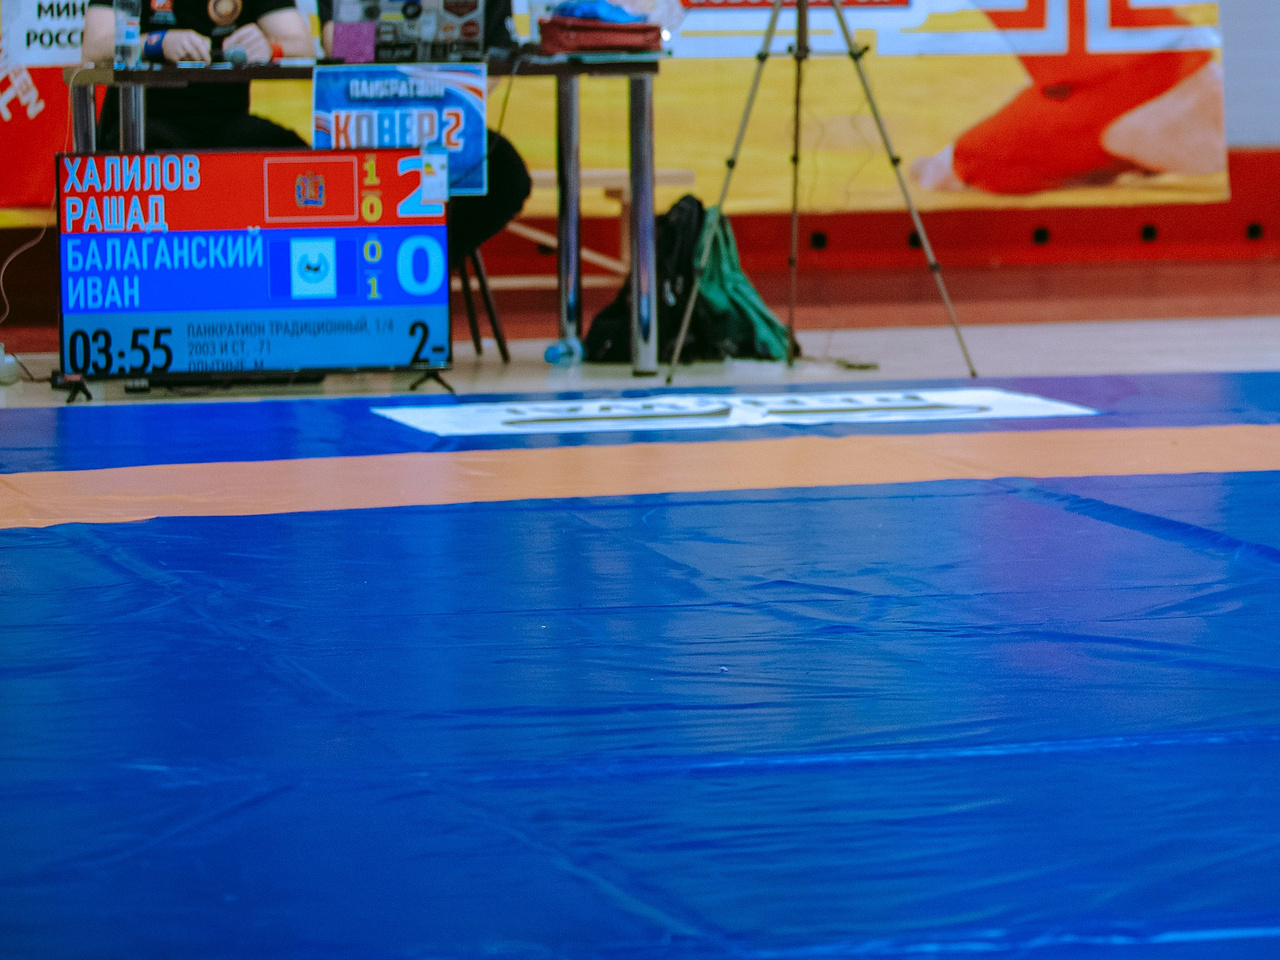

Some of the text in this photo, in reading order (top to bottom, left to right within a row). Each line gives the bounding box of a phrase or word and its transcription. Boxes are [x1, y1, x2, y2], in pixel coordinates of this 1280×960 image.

[26, 29, 84, 49] РОСС
[332, 109, 464, 149] КОВЕР 2
[64, 154, 201, 193] ХАЛИЛОВ
[363, 160, 380, 186] 1
[397, 156, 445, 218] 2
[65, 195, 168, 233] РАШАД
[361, 196, 383, 223] 0
[67, 226, 264, 272] БАЛАГАНСКИЙ
[363, 240, 382, 262] 0
[396, 234, 445, 296] 0
[67, 274, 140, 310] ИВАН
[366, 277, 382, 300] 1
[69, 327, 173, 375] 03:55
